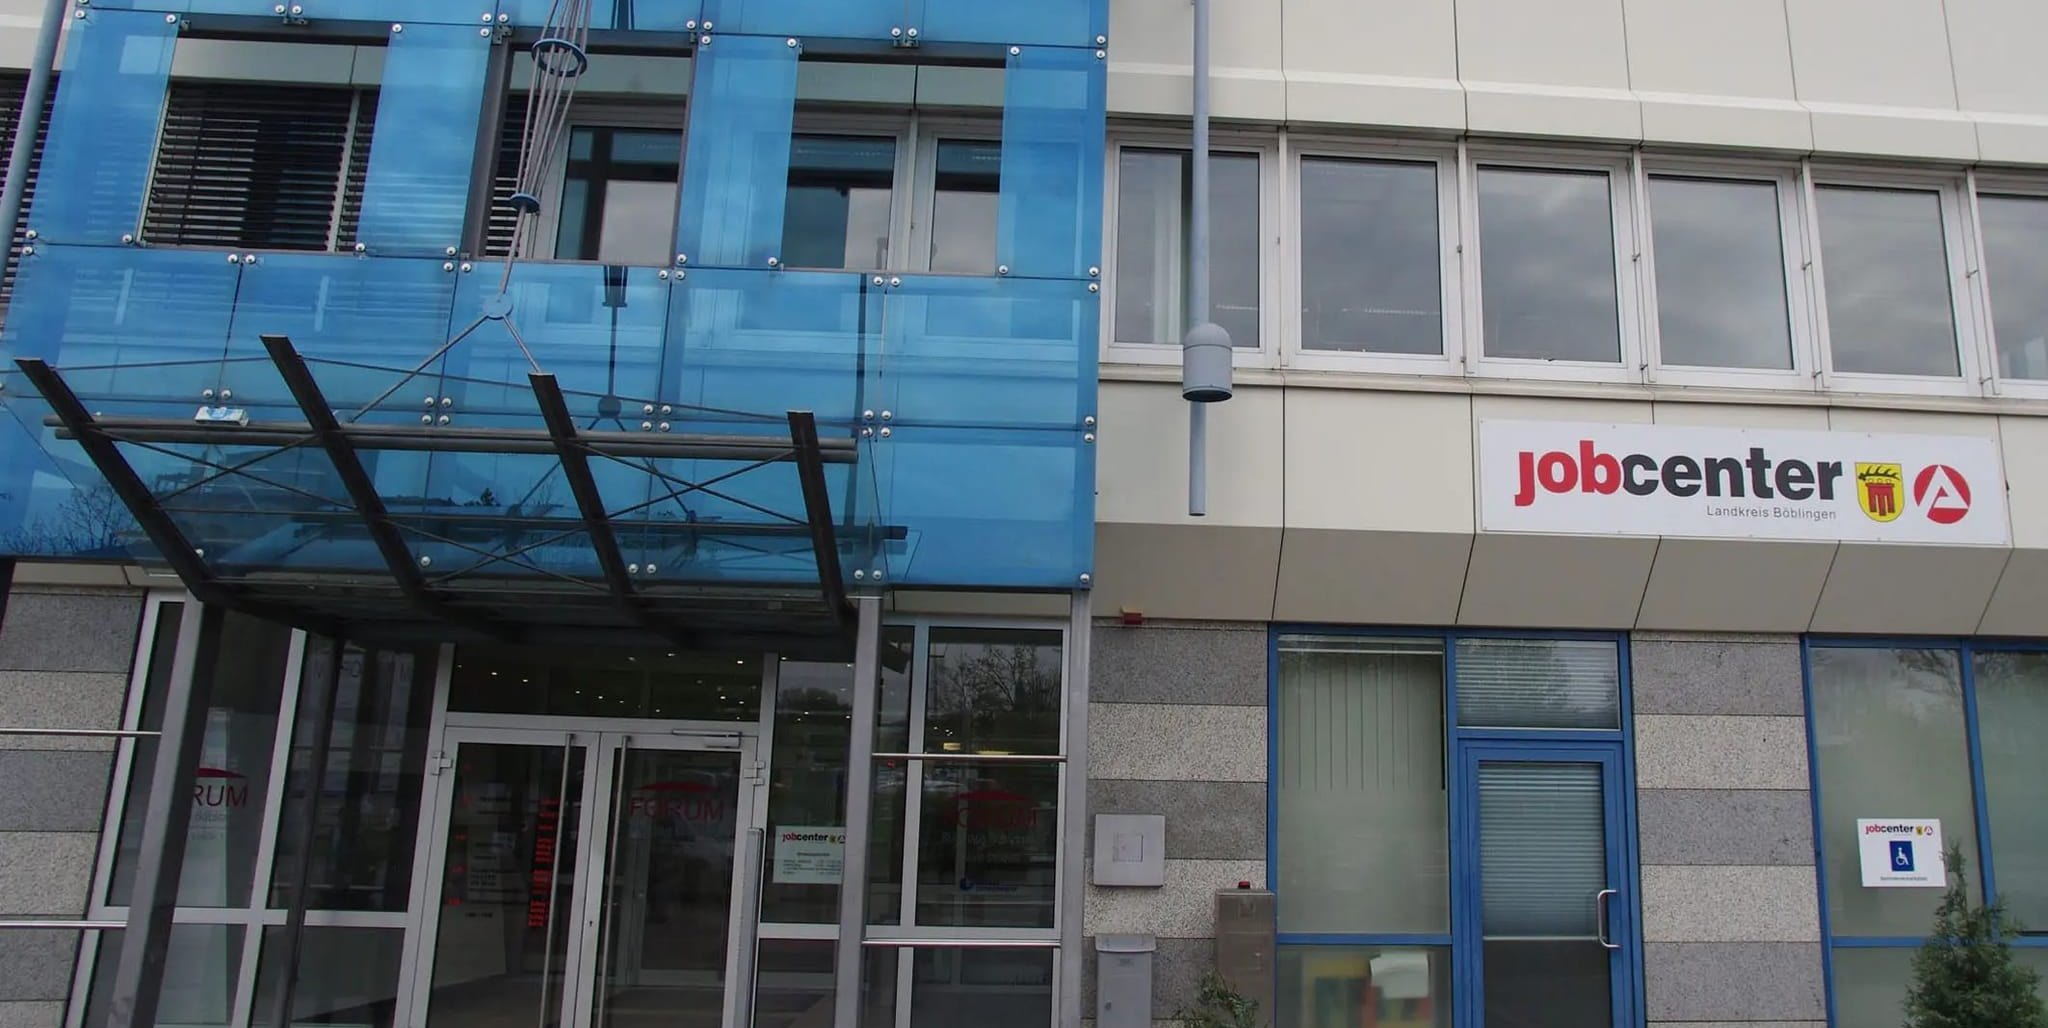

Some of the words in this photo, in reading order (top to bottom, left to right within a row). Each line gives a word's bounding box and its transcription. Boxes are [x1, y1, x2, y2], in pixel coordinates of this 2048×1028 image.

[1514, 439, 1843, 506] jobcenter
[1706, 505, 1769, 518] Landkreis
[1773, 507, 1837, 521] Böblingen
[1865, 824, 1914, 835] jobcenter
[782, 832, 828, 842] jobcenter
